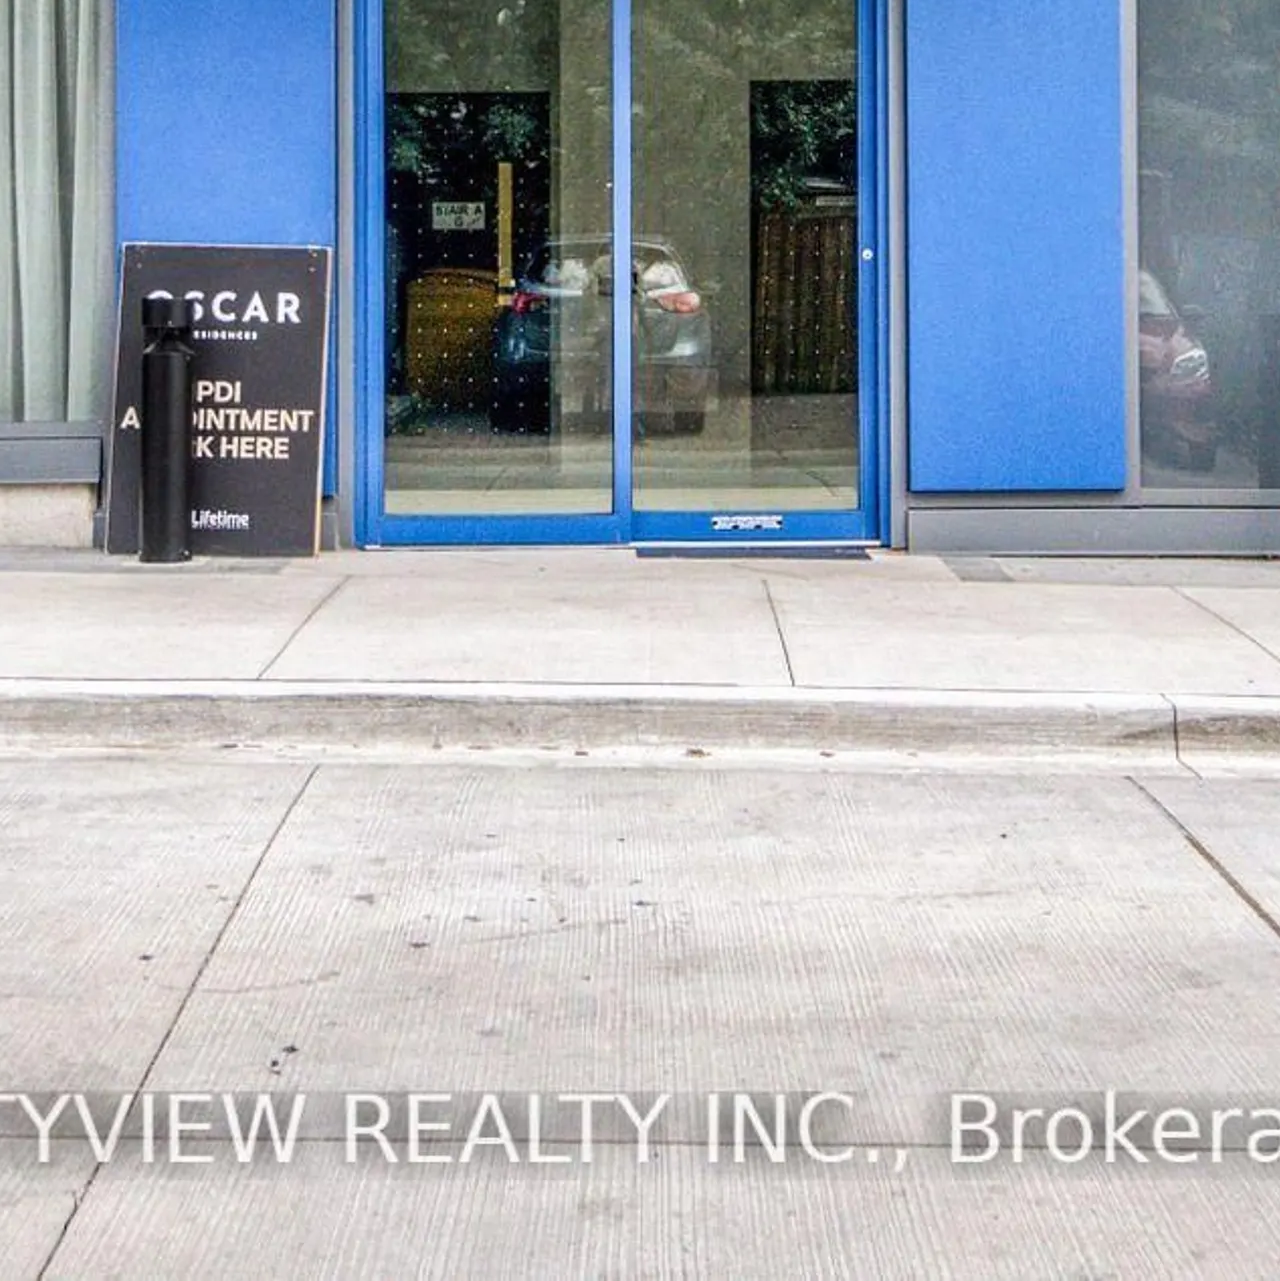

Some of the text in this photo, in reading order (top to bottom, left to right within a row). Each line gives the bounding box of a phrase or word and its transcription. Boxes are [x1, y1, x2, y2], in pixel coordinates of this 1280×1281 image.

[147, 290, 302, 324] SCAR
[193, 329, 258, 340] ESIDENCES
[196, 380, 242, 403] PDI
[120, 406, 314, 433] AINTMENT
[220, 436, 290, 460] HERE
[191, 509, 249, 529] Lifetime
